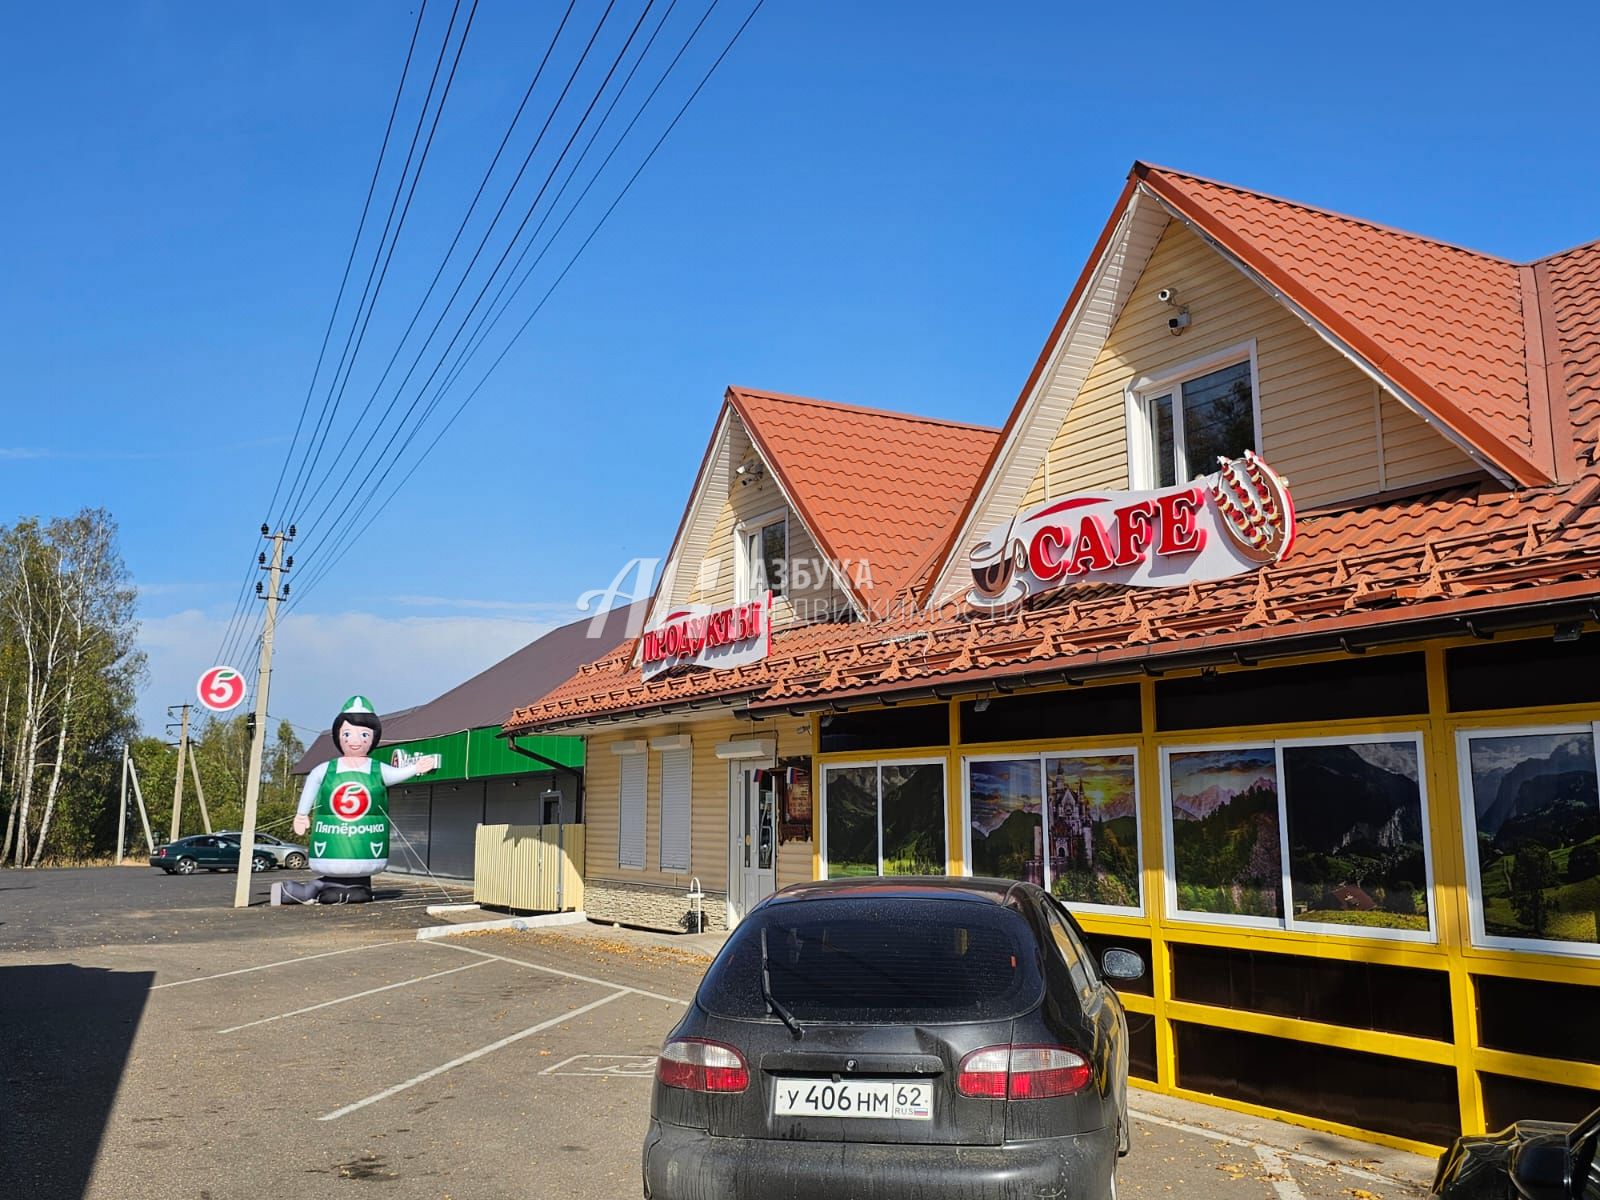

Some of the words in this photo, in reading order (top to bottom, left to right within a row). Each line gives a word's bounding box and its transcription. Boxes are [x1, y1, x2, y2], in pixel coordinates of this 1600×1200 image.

[1028, 487, 1207, 581] CAFE
[642, 600, 762, 663] ПРОДУКТЫ
[208, 671, 235, 704] 5
[339, 788, 363, 814] 5
[315, 821, 385, 837] Пятёрочка
[895, 1107, 914, 1115] RUS
